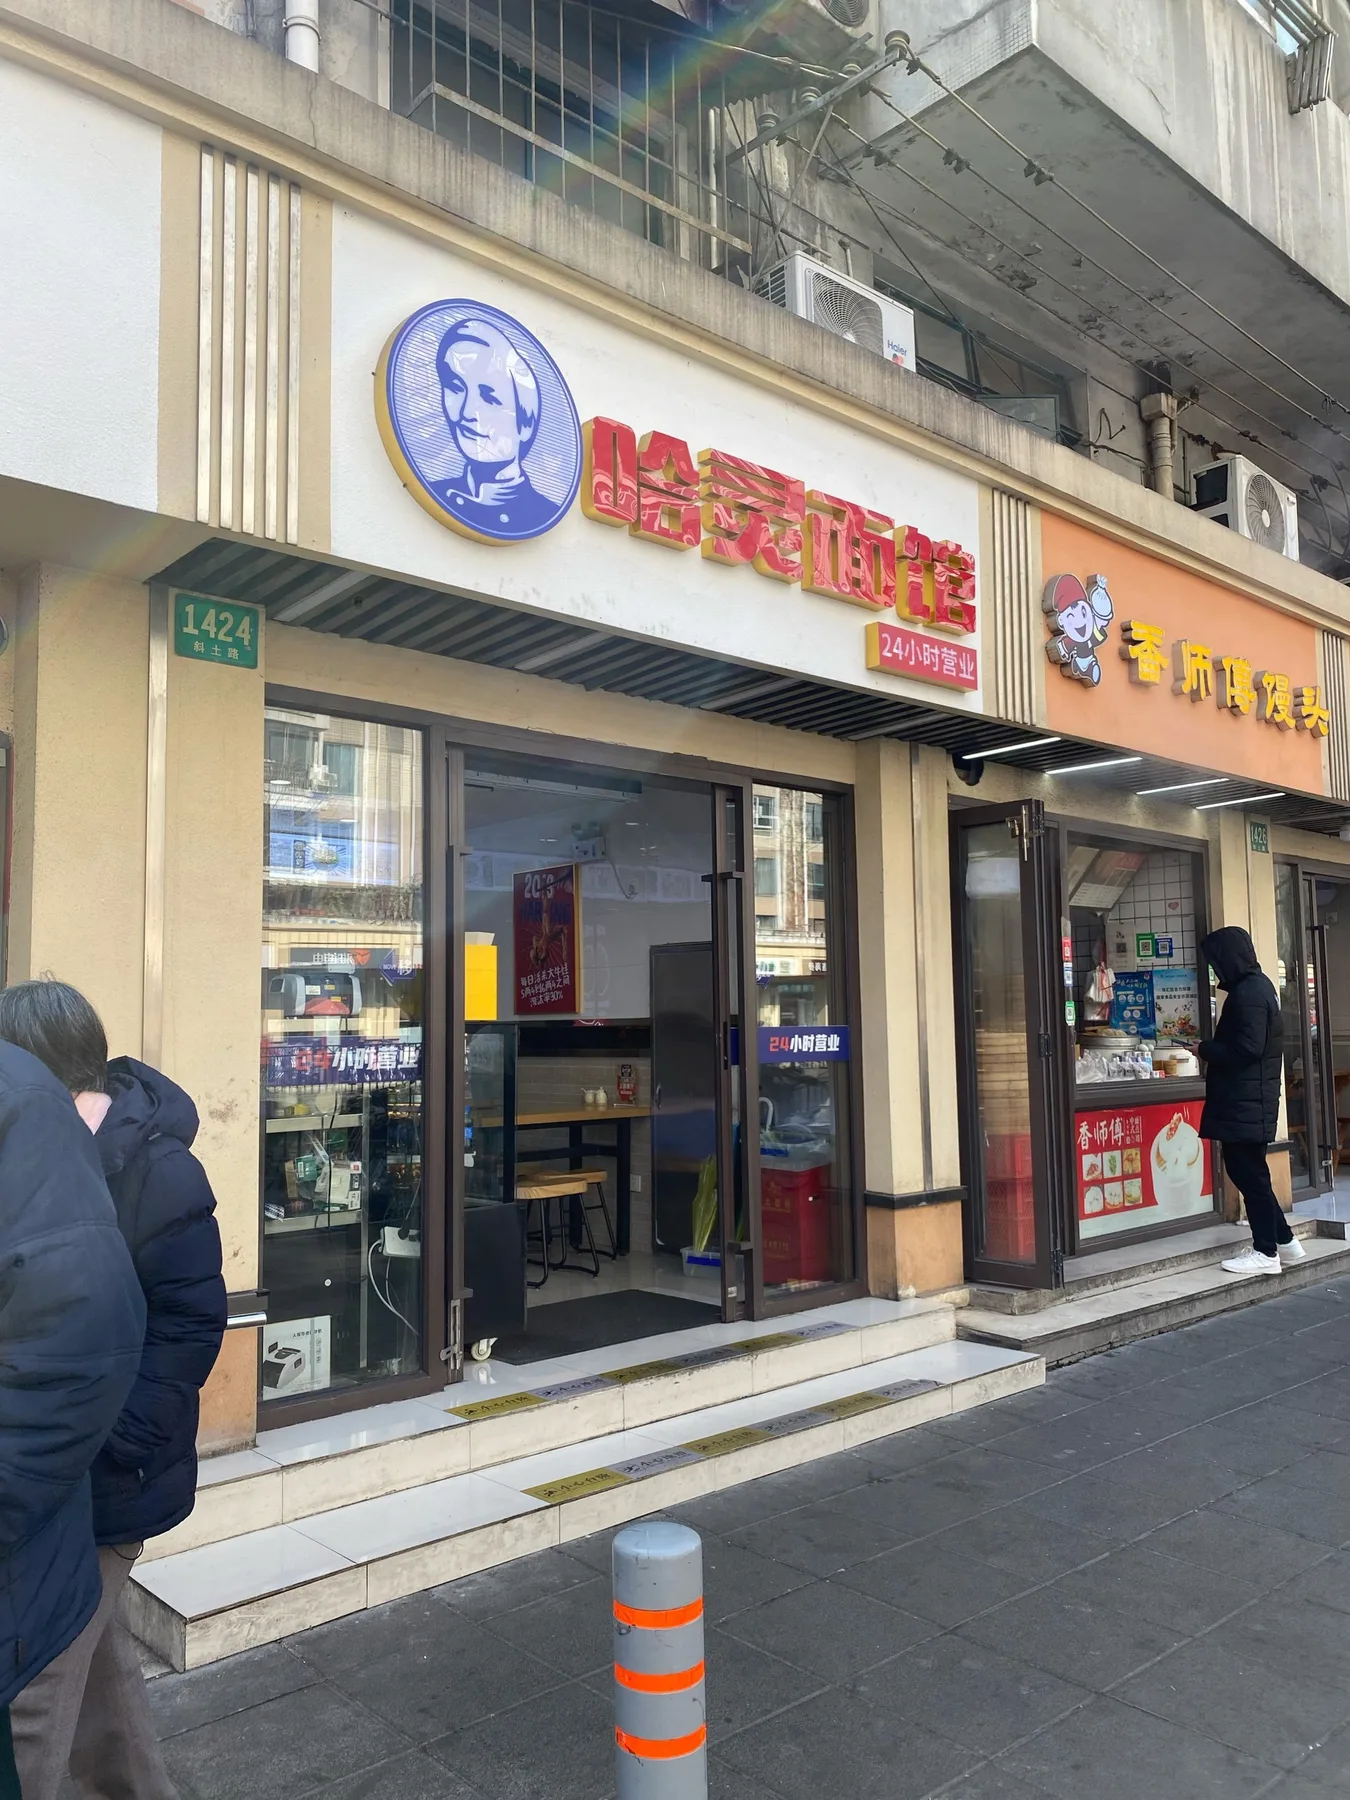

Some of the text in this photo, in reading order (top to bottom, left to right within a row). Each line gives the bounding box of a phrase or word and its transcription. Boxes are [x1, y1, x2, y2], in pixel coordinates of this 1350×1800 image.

[887, 339, 907, 357] Haier
[582, 415, 977, 637] 哈灵面馆
[182, 603, 252, 646] 1424
[193, 640, 239, 660] 斜土路
[881, 632, 975, 682] 24小时营业
[296, 1045, 421, 1072] 24小时营业
[768, 1033, 841, 1053] 24小时营业
[1077, 1116, 1125, 1151] 香师傅
